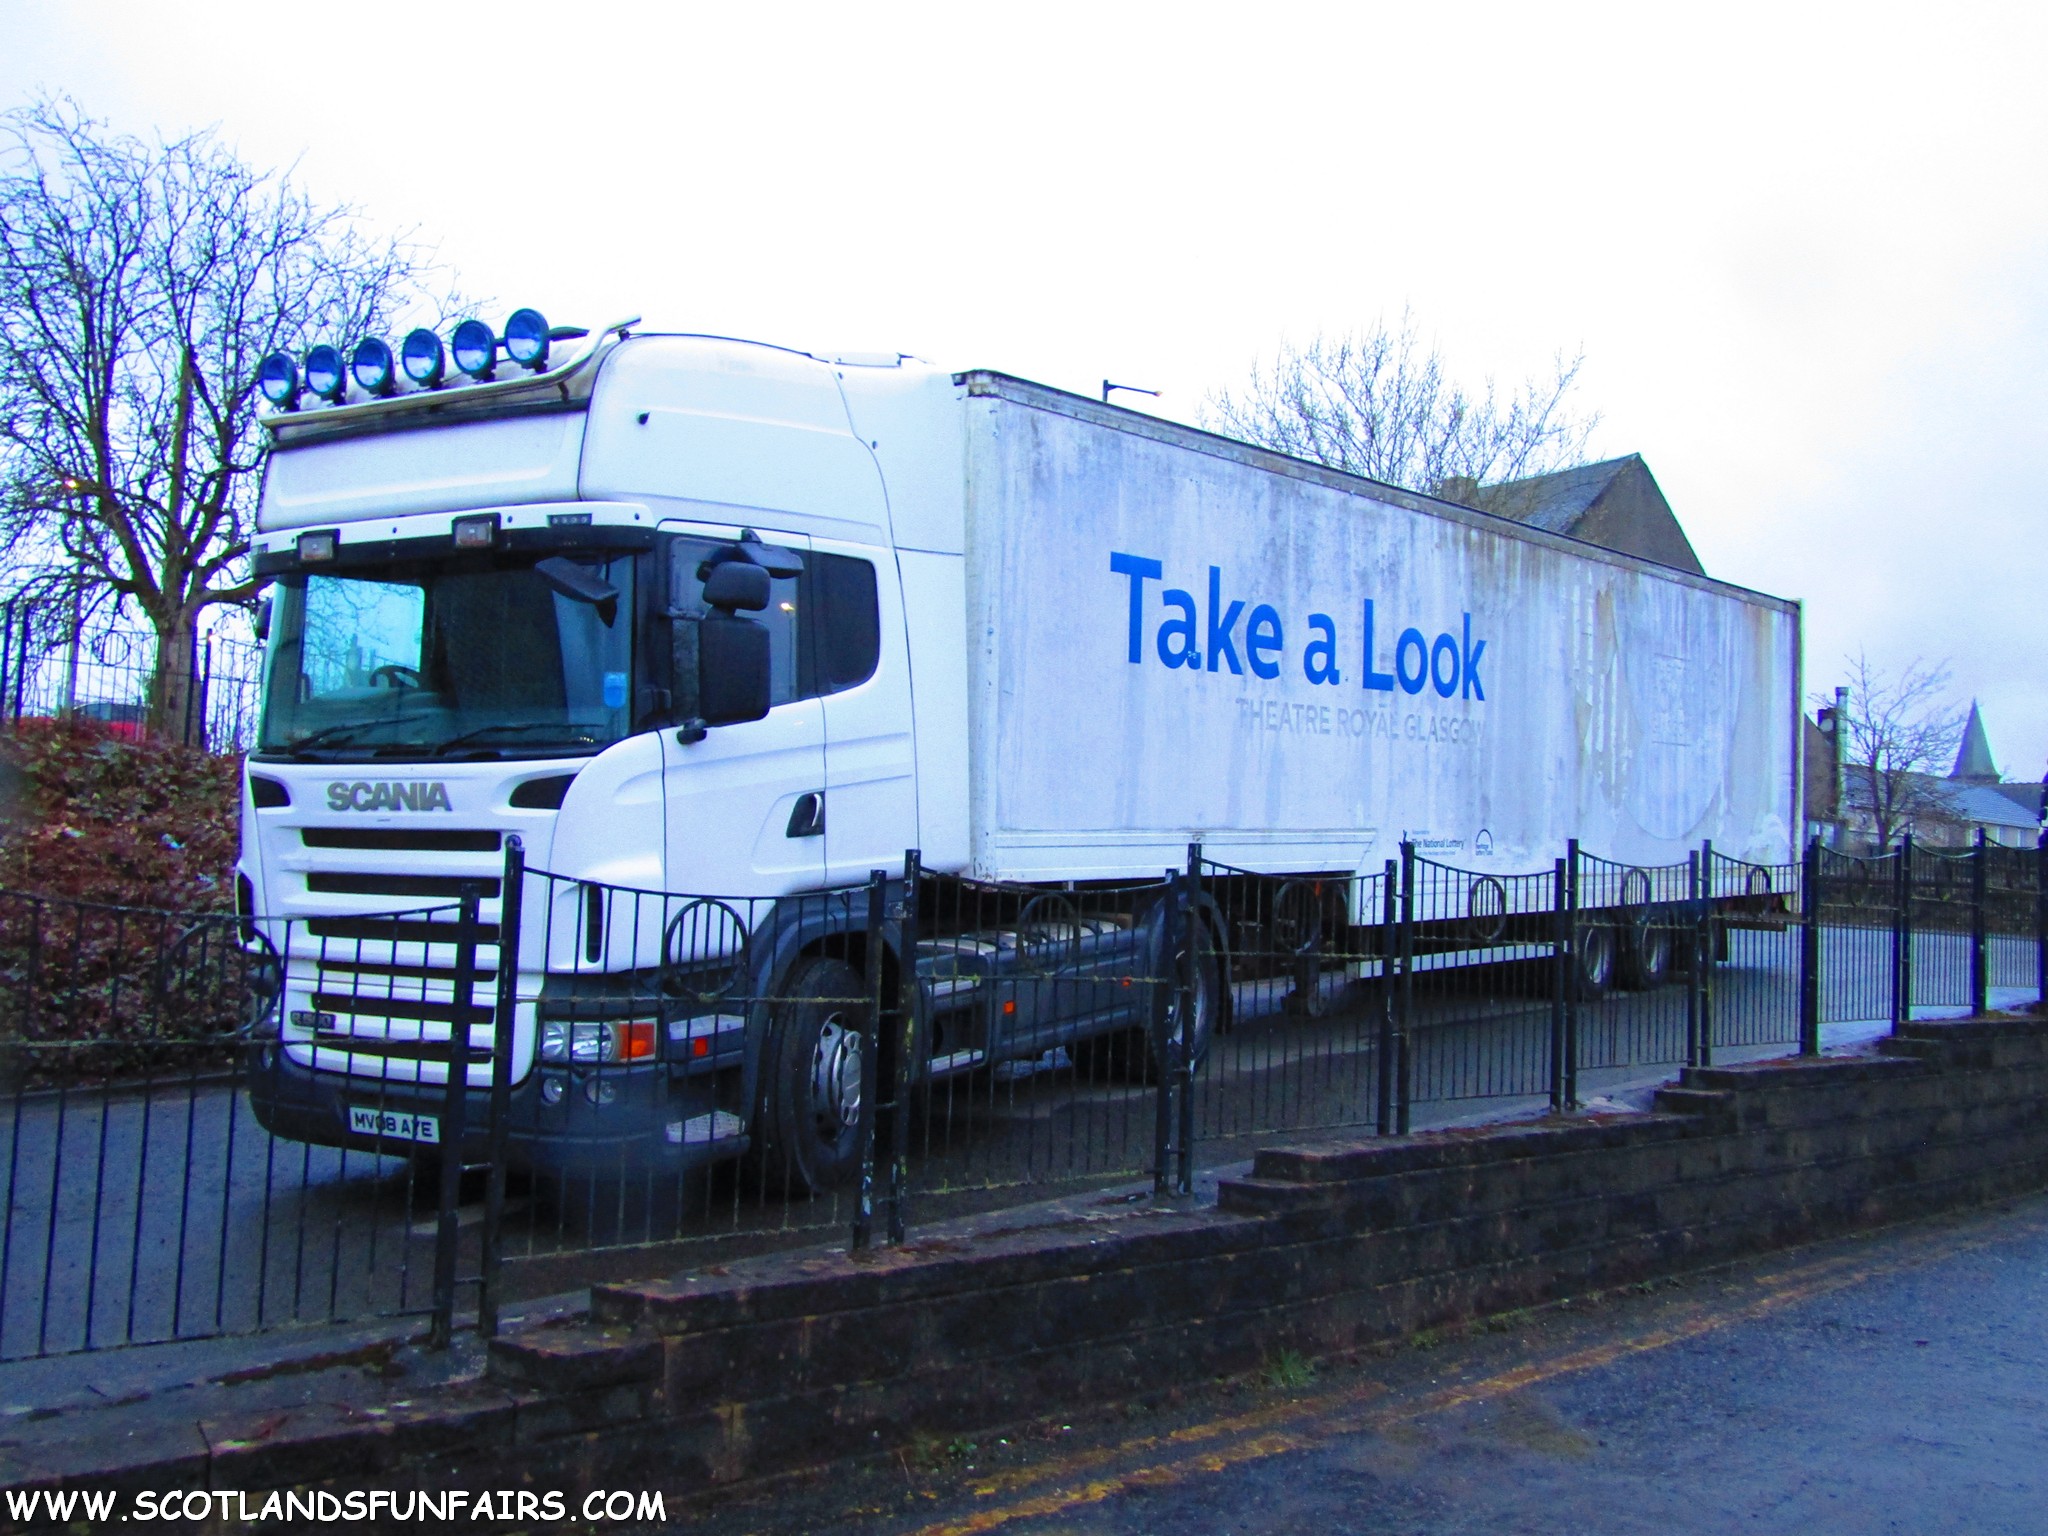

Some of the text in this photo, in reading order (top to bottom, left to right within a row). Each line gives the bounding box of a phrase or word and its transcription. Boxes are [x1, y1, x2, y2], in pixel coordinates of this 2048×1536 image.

[1110, 552, 1486, 700] Take a Look
[1236, 698, 1486, 744] THEATRE ROYAL GLASGOW
[327, 781, 453, 811] SCANIA
[355, 1112, 397, 1132] MV08
